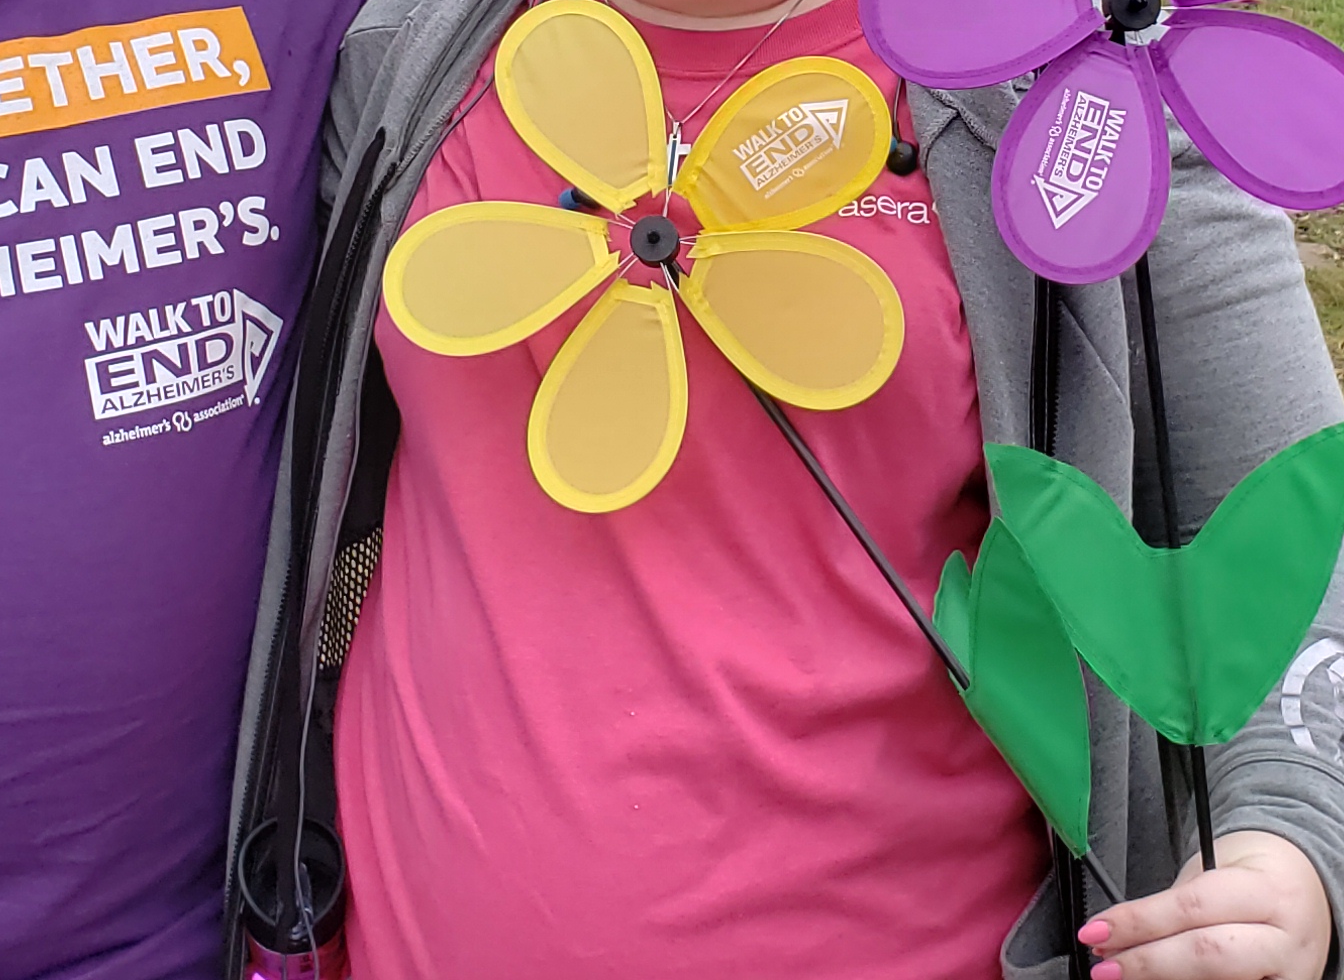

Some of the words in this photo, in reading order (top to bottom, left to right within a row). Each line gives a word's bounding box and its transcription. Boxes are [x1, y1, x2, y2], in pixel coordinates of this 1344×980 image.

[134, 119, 267, 189] END
[732, 121, 784, 161] WALK
[777, 106, 804, 128] TO
[749, 122, 815, 179] END
[1054, 93, 1087, 178] ALZHEIMER'S
[1065, 101, 1107, 183] END
[1093, 109, 1127, 165] WALK
[1085, 165, 1109, 191] TO
[84, 301, 193, 352] WALK
[190, 290, 232, 327] TO
[94, 332, 235, 396] END
[100, 365, 236, 415] ALZHEIMER'S
[102, 419, 171, 446] alzheimer's
[193, 394, 244, 422] association
